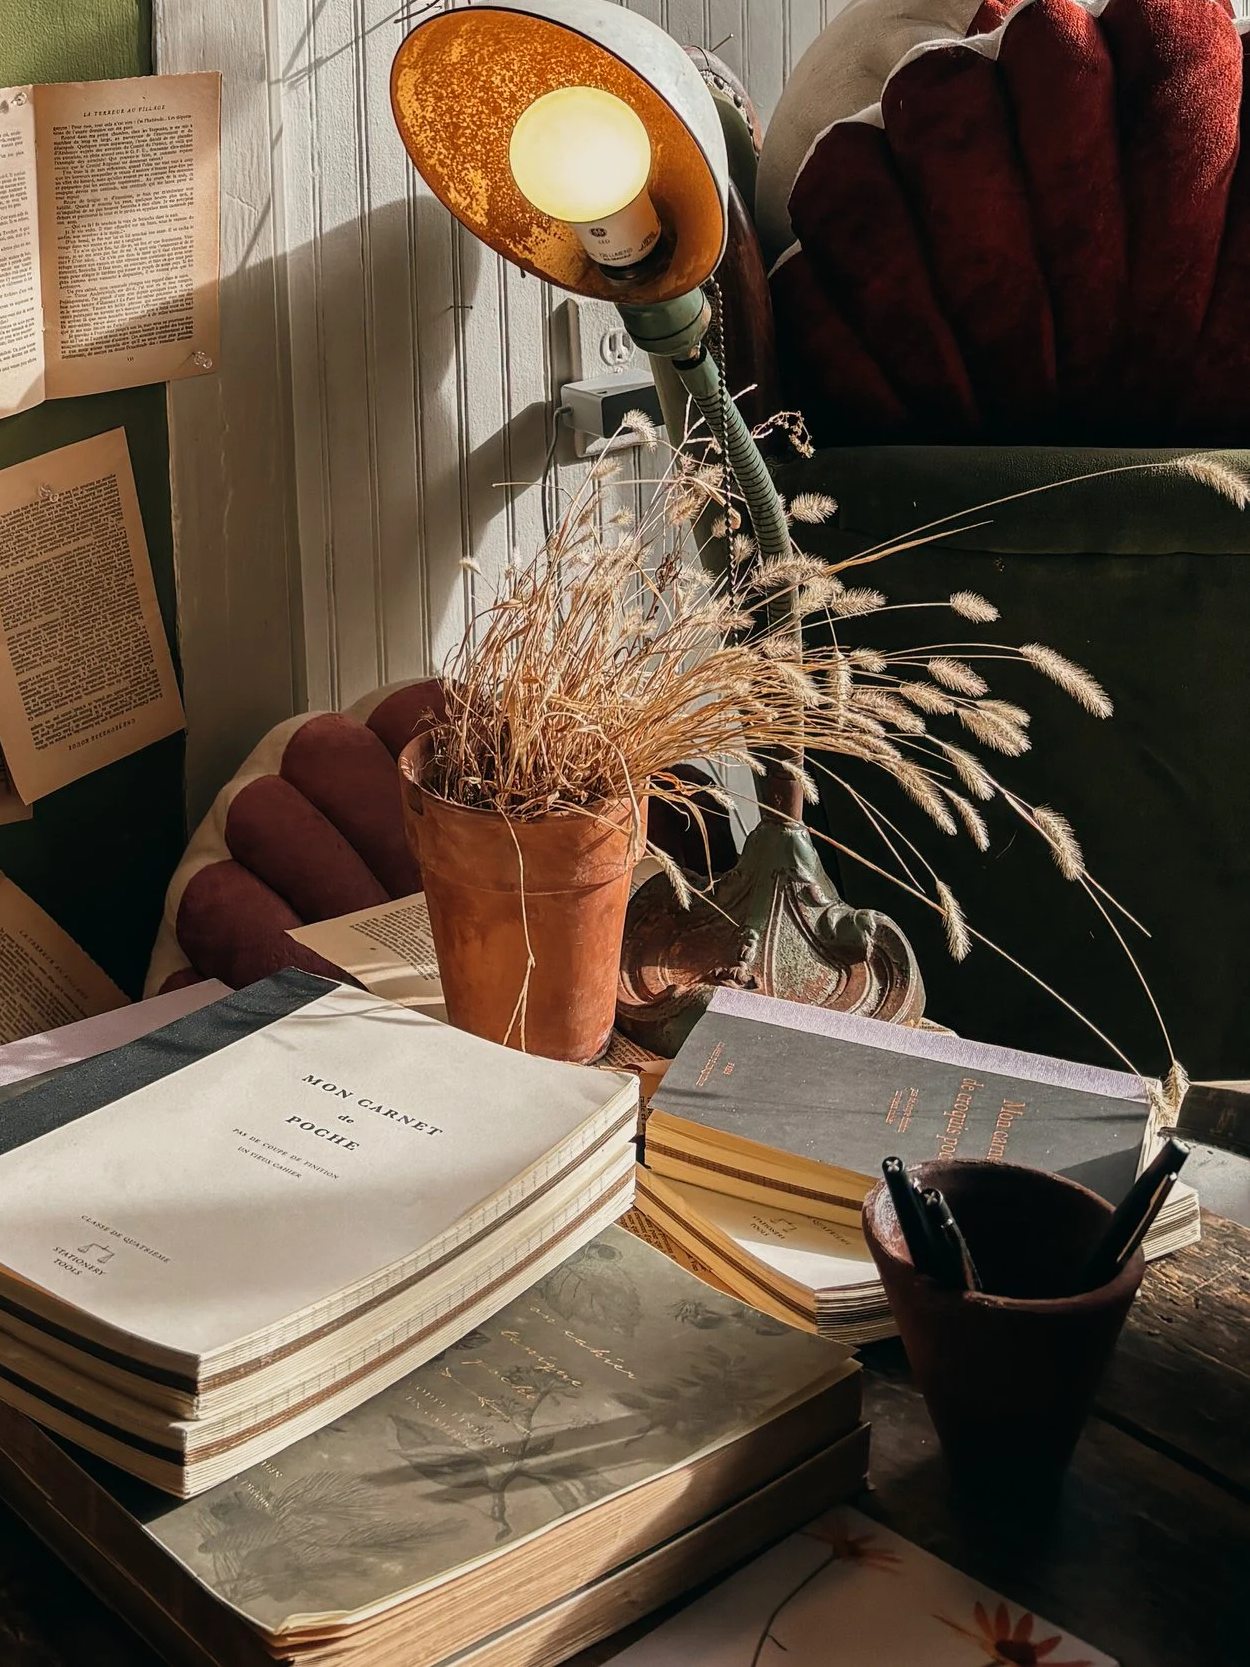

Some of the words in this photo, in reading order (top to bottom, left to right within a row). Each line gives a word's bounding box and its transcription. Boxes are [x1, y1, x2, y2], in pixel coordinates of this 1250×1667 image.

[961, 1078, 984, 1091] de
[301, 1074, 354, 1099] MON
[357, 1097, 443, 1136] CARNET
[337, 1113, 355, 1124] de
[943, 1092, 972, 1135] croquis
[996, 1098, 1025, 1128] Mon
[285, 1115, 360, 1151] POCHE
[936, 1133, 958, 1161] poc
[232, 1128, 248, 1136] PAS
[248, 1136, 260, 1144] DE
[262, 1142, 289, 1156] COUPE
[289, 1154, 302, 1162] DE
[303, 1160, 340, 1180] FINITION
[237, 1145, 249, 1154] UN
[250, 1151, 272, 1167] VIEUX
[272, 1162, 302, 1179] CAHIER
[81, 1214, 111, 1232] CLASSE
[110, 1230, 123, 1238] DE
[52, 1246, 106, 1276] STATIONERY
[53, 1258, 83, 1276] TOOLS
